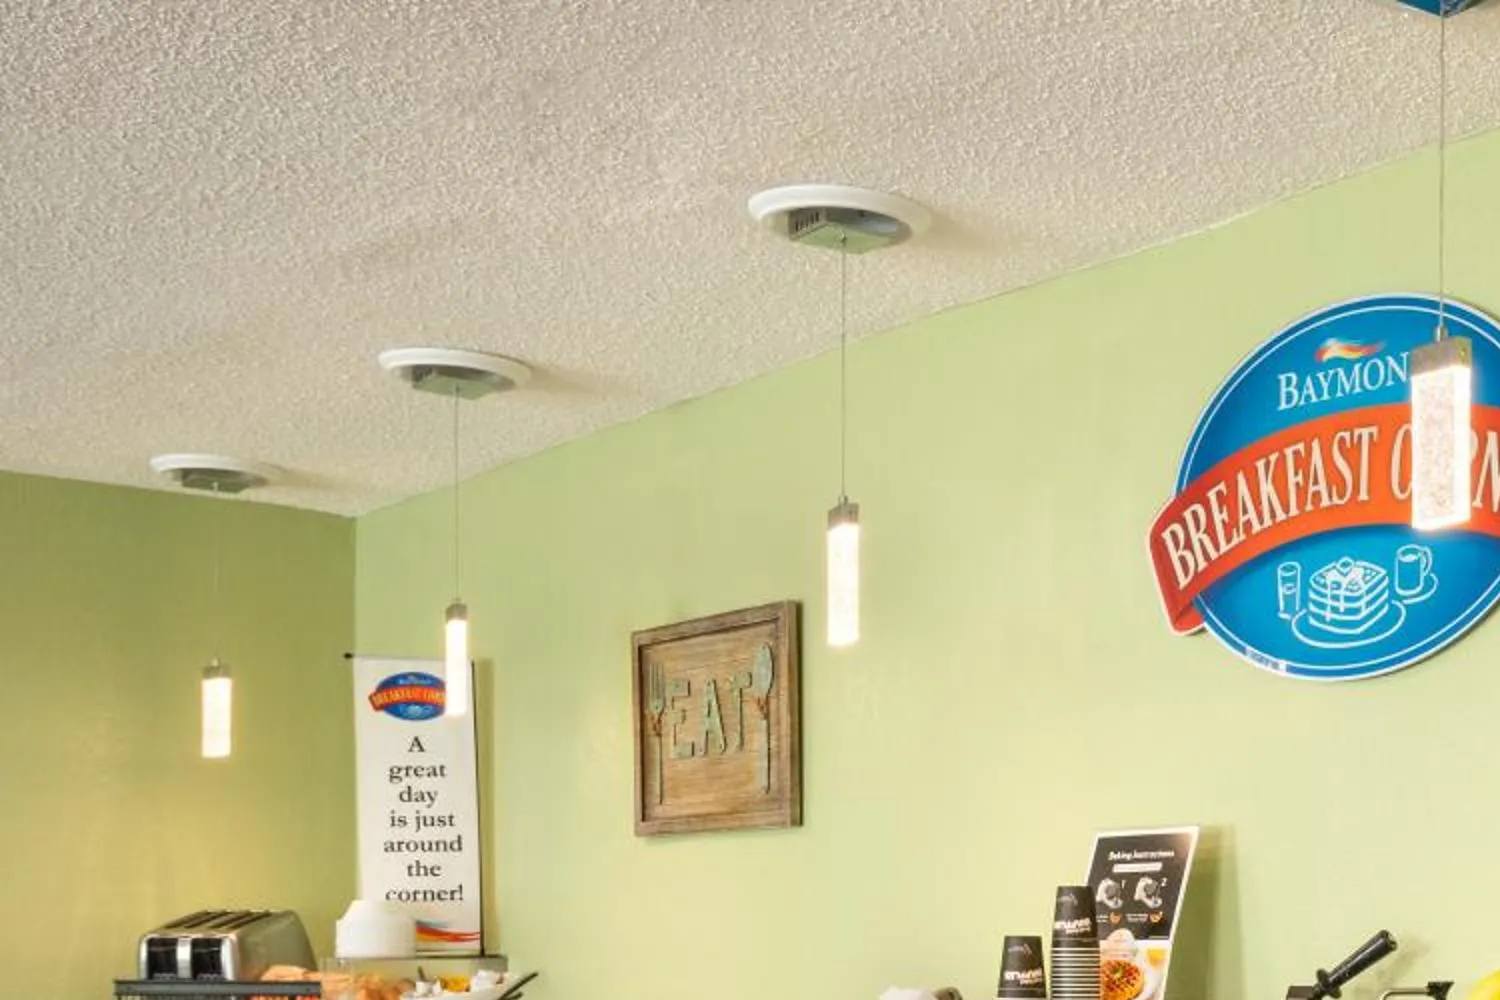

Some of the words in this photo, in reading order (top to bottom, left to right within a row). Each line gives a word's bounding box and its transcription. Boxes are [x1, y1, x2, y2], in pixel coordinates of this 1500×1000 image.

[1278, 351, 1411, 411] BAYMON
[1162, 426, 1379, 590] BREAKFAST
[665, 670, 753, 760] EAT
[407, 735, 426, 753] A
[388, 764, 448, 784] great
[398, 785, 438, 809] day
[390, 809, 408, 828] is
[415, 809, 456, 833] just
[383, 833, 463, 853] around
[406, 859, 442, 878] the
[385, 883, 465, 902] corner!
